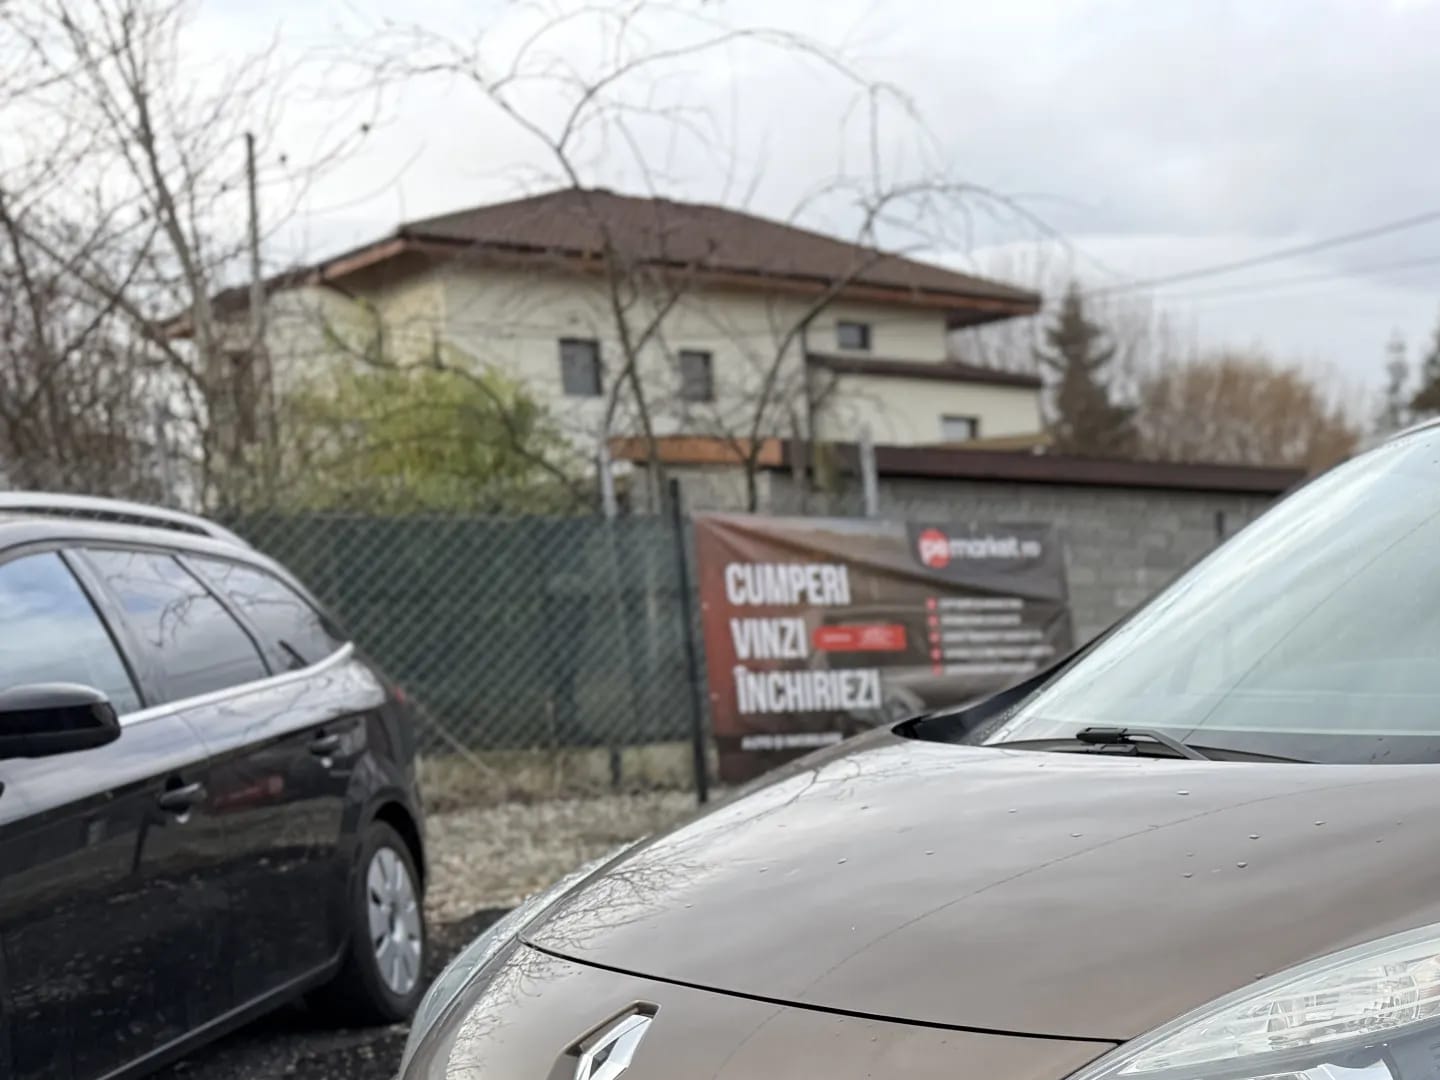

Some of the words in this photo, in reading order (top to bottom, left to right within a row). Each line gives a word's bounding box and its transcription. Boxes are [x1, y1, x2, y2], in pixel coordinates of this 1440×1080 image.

[725, 562, 851, 605] CUMPERI
[730, 617, 808, 659] VINZI
[733, 666, 881, 713] ÎNCHIRIEZI
